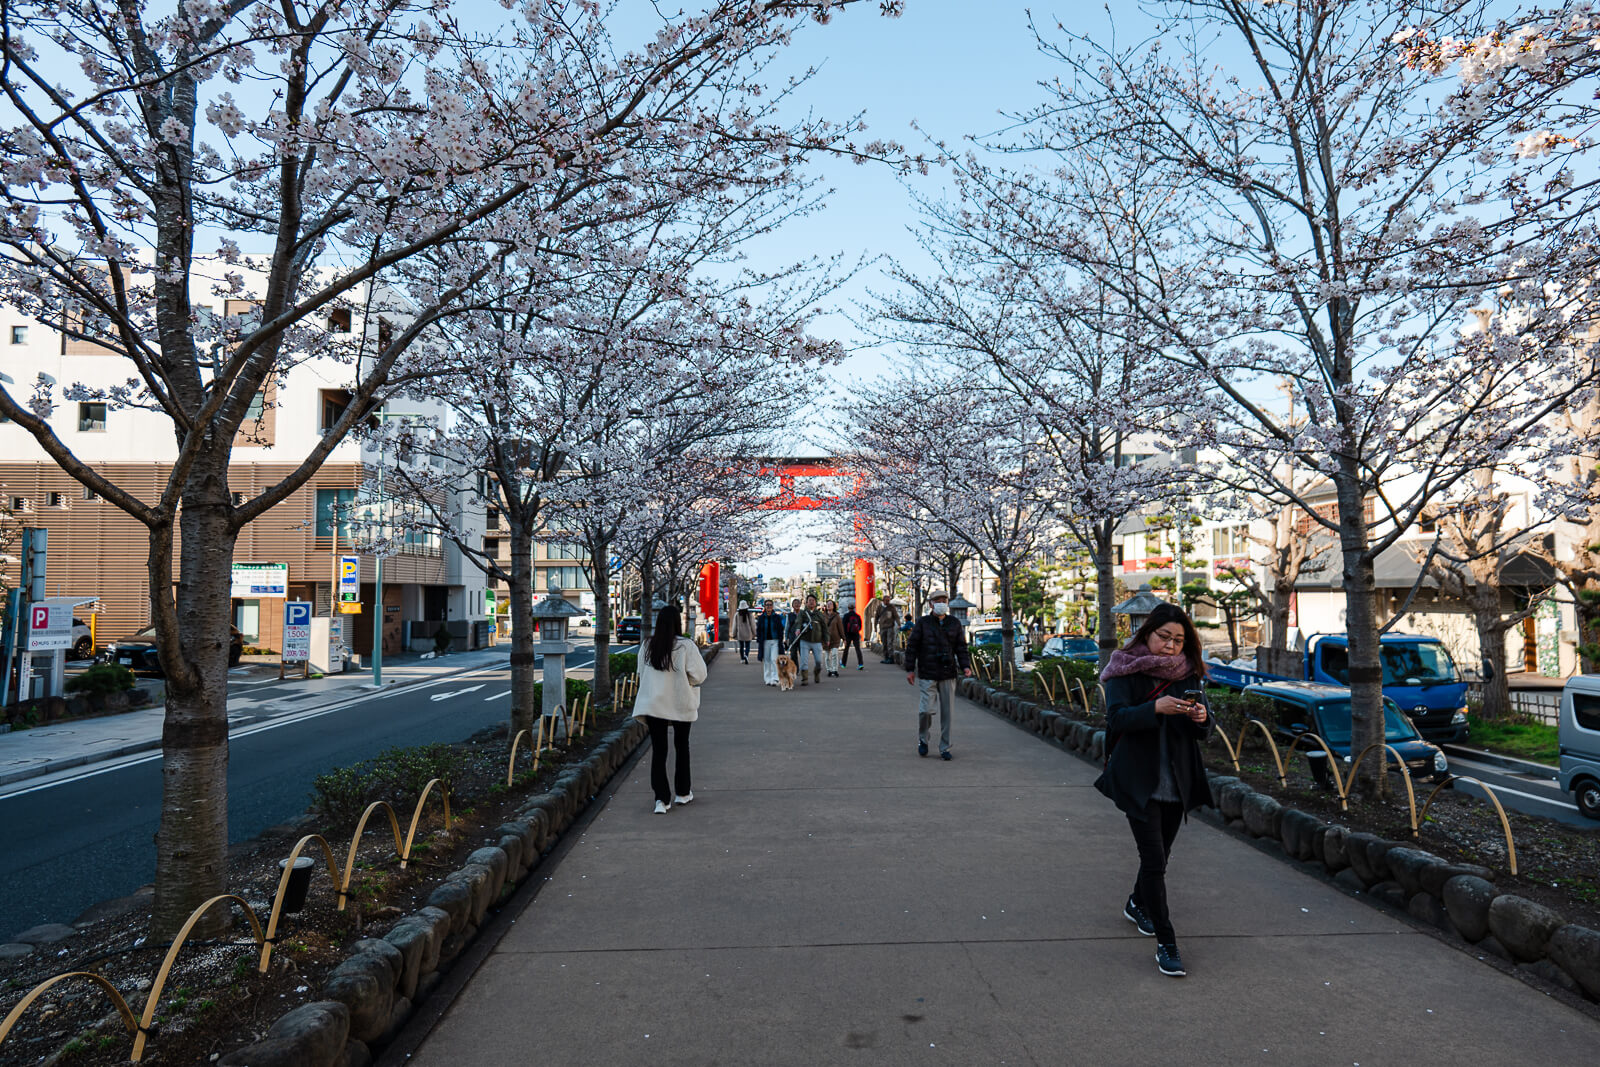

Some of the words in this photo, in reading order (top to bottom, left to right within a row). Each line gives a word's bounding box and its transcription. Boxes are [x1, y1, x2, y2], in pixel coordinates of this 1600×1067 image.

[342, 562, 356, 578] P
[36, 610, 46, 627] P
[289, 605, 307, 624] P
